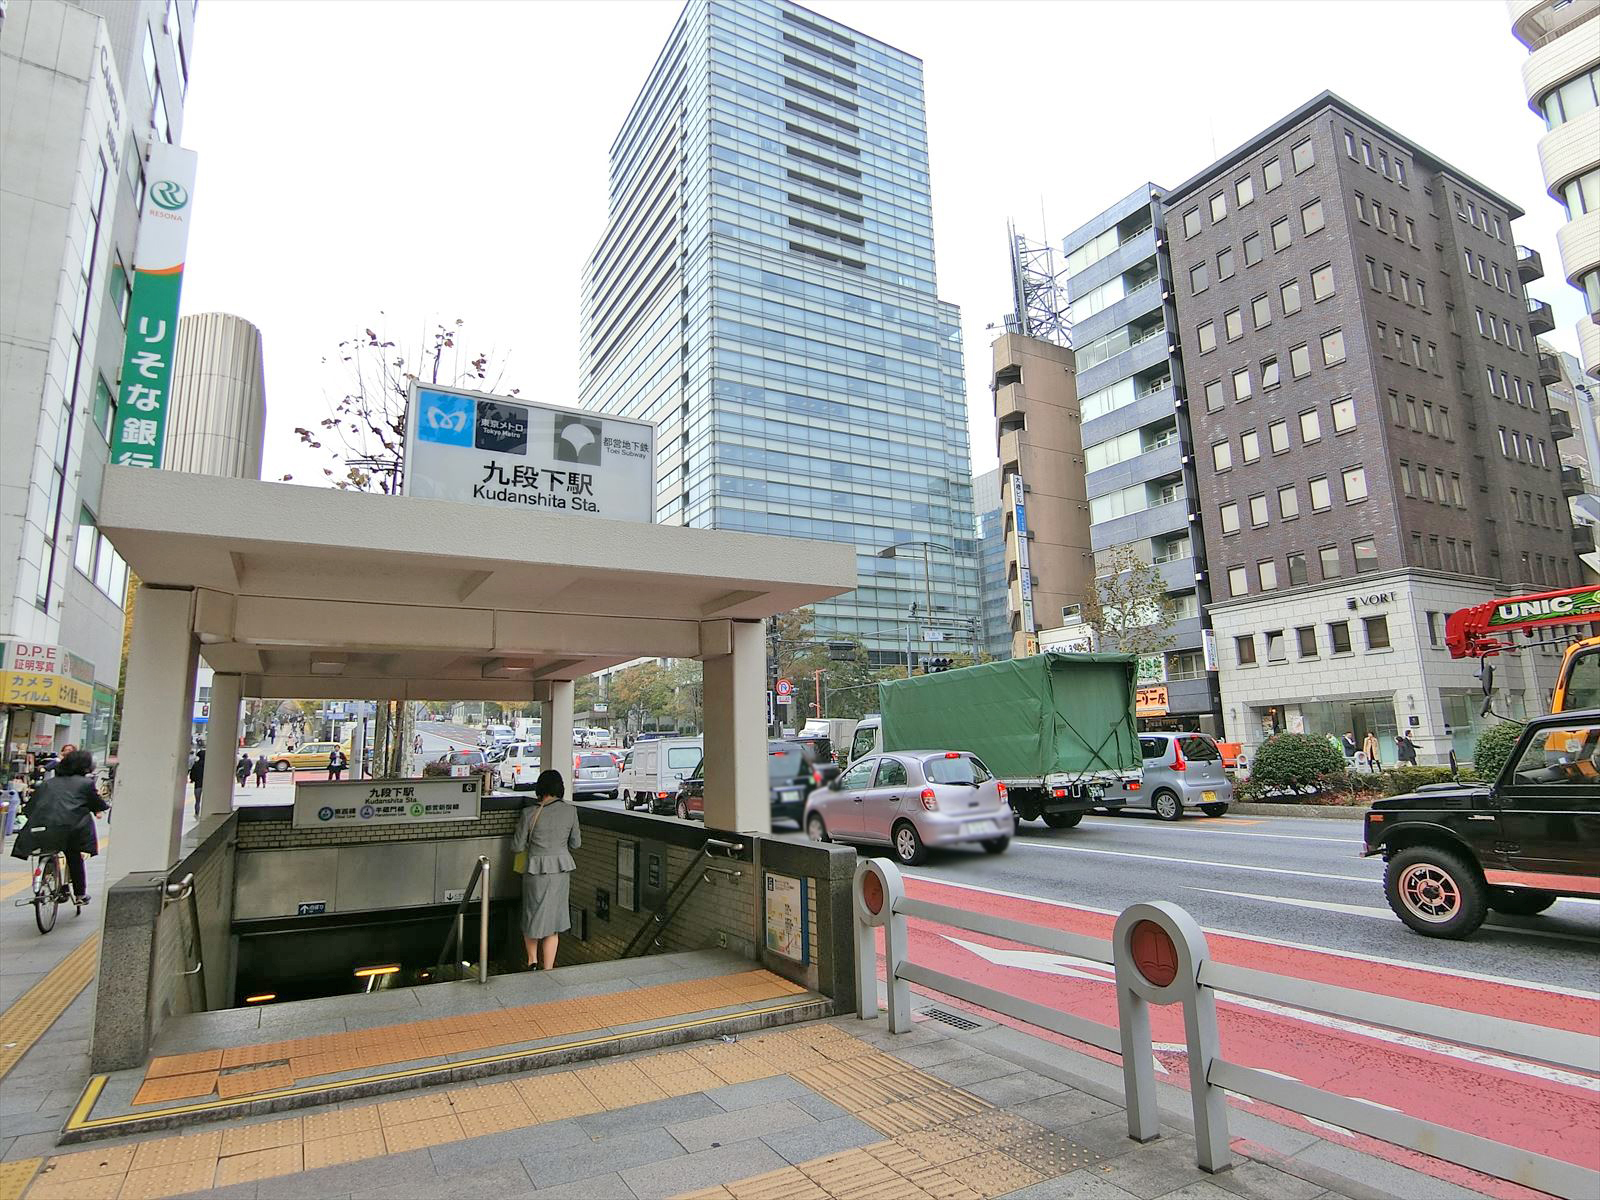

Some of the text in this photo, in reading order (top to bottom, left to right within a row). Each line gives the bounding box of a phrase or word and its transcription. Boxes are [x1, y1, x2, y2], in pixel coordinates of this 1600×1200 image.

[150, 209, 183, 222] RESONA
[480, 417, 524, 433] 東京メトロ
[483, 427, 521, 439] Tokyo Metro
[603, 437, 650, 453] 都営地下鉄
[607, 447, 647, 460] Toei Subway
[482, 460, 594, 497] 九段下駅
[473, 484, 601, 513] Kudanshita Sta.
[1359, 591, 1398, 606] VORT
[1498, 596, 1574, 619] UNIC
[16, 644, 57, 660] D.P.E
[14, 659, 56, 673] 証明写真
[12, 676, 54, 689] カメラ
[369, 787, 415, 798] 九段下駅
[466, 783, 473, 792] 6
